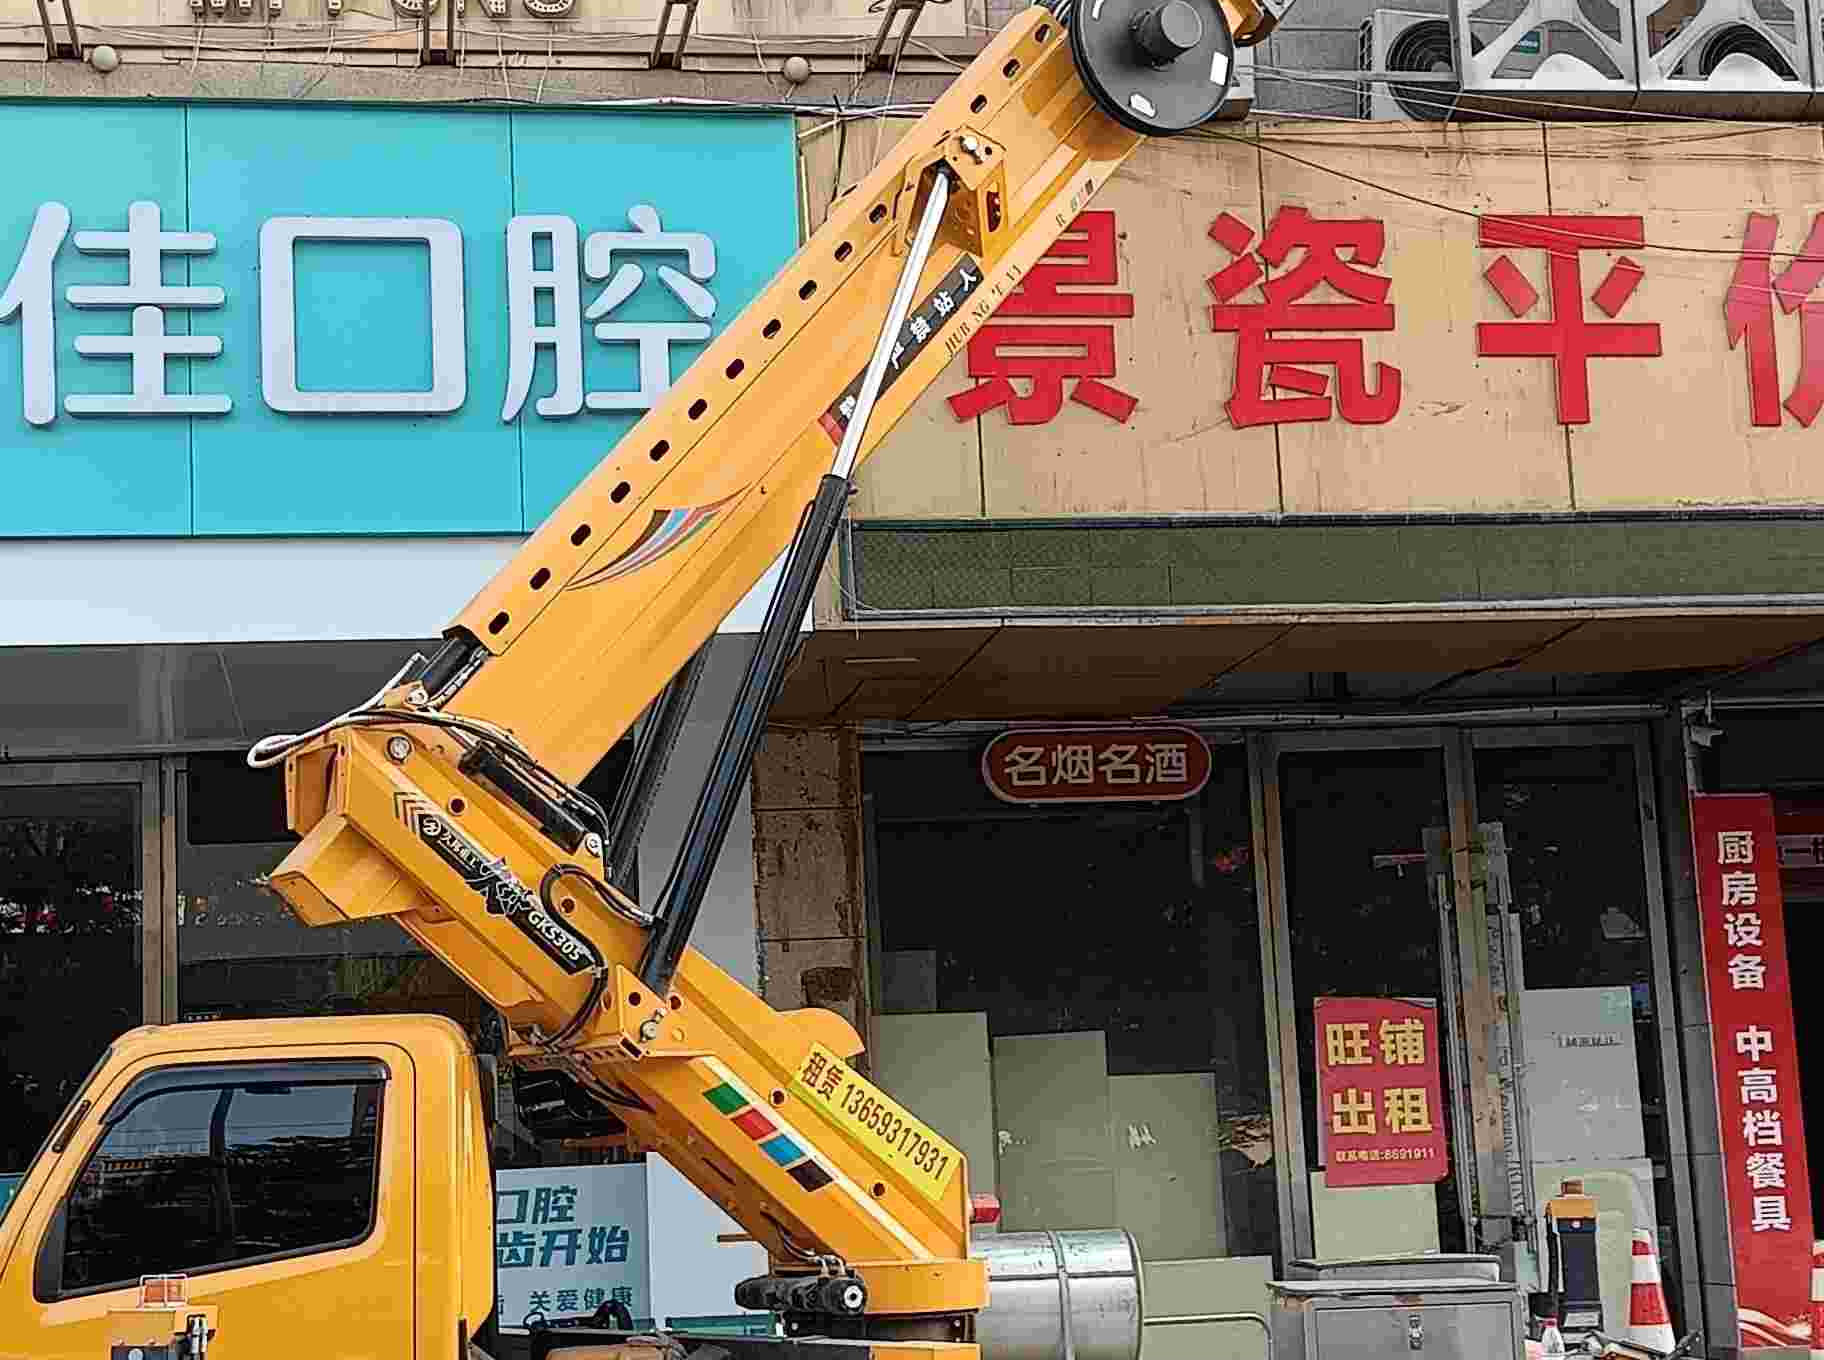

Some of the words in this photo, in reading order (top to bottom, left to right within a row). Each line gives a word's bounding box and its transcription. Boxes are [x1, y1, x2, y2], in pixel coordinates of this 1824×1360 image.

[0, 200, 718, 426] 佳口腔
[1003, 743, 1188, 786] 名烟名酒
[1717, 830, 1766, 991] 厨房设备
[527, 910, 581, 961] GKS305
[1325, 1019, 1425, 1066] 旺铺
[800, 1051, 845, 1101] 租赁
[840, 1083, 949, 1180] 13659317931
[1331, 1087, 1433, 1135] 出租
[1735, 1024, 1793, 1234] 中高档餐具
[496, 1185, 578, 1224] 口腔
[529, 1285, 633, 1313] 关爱健康
